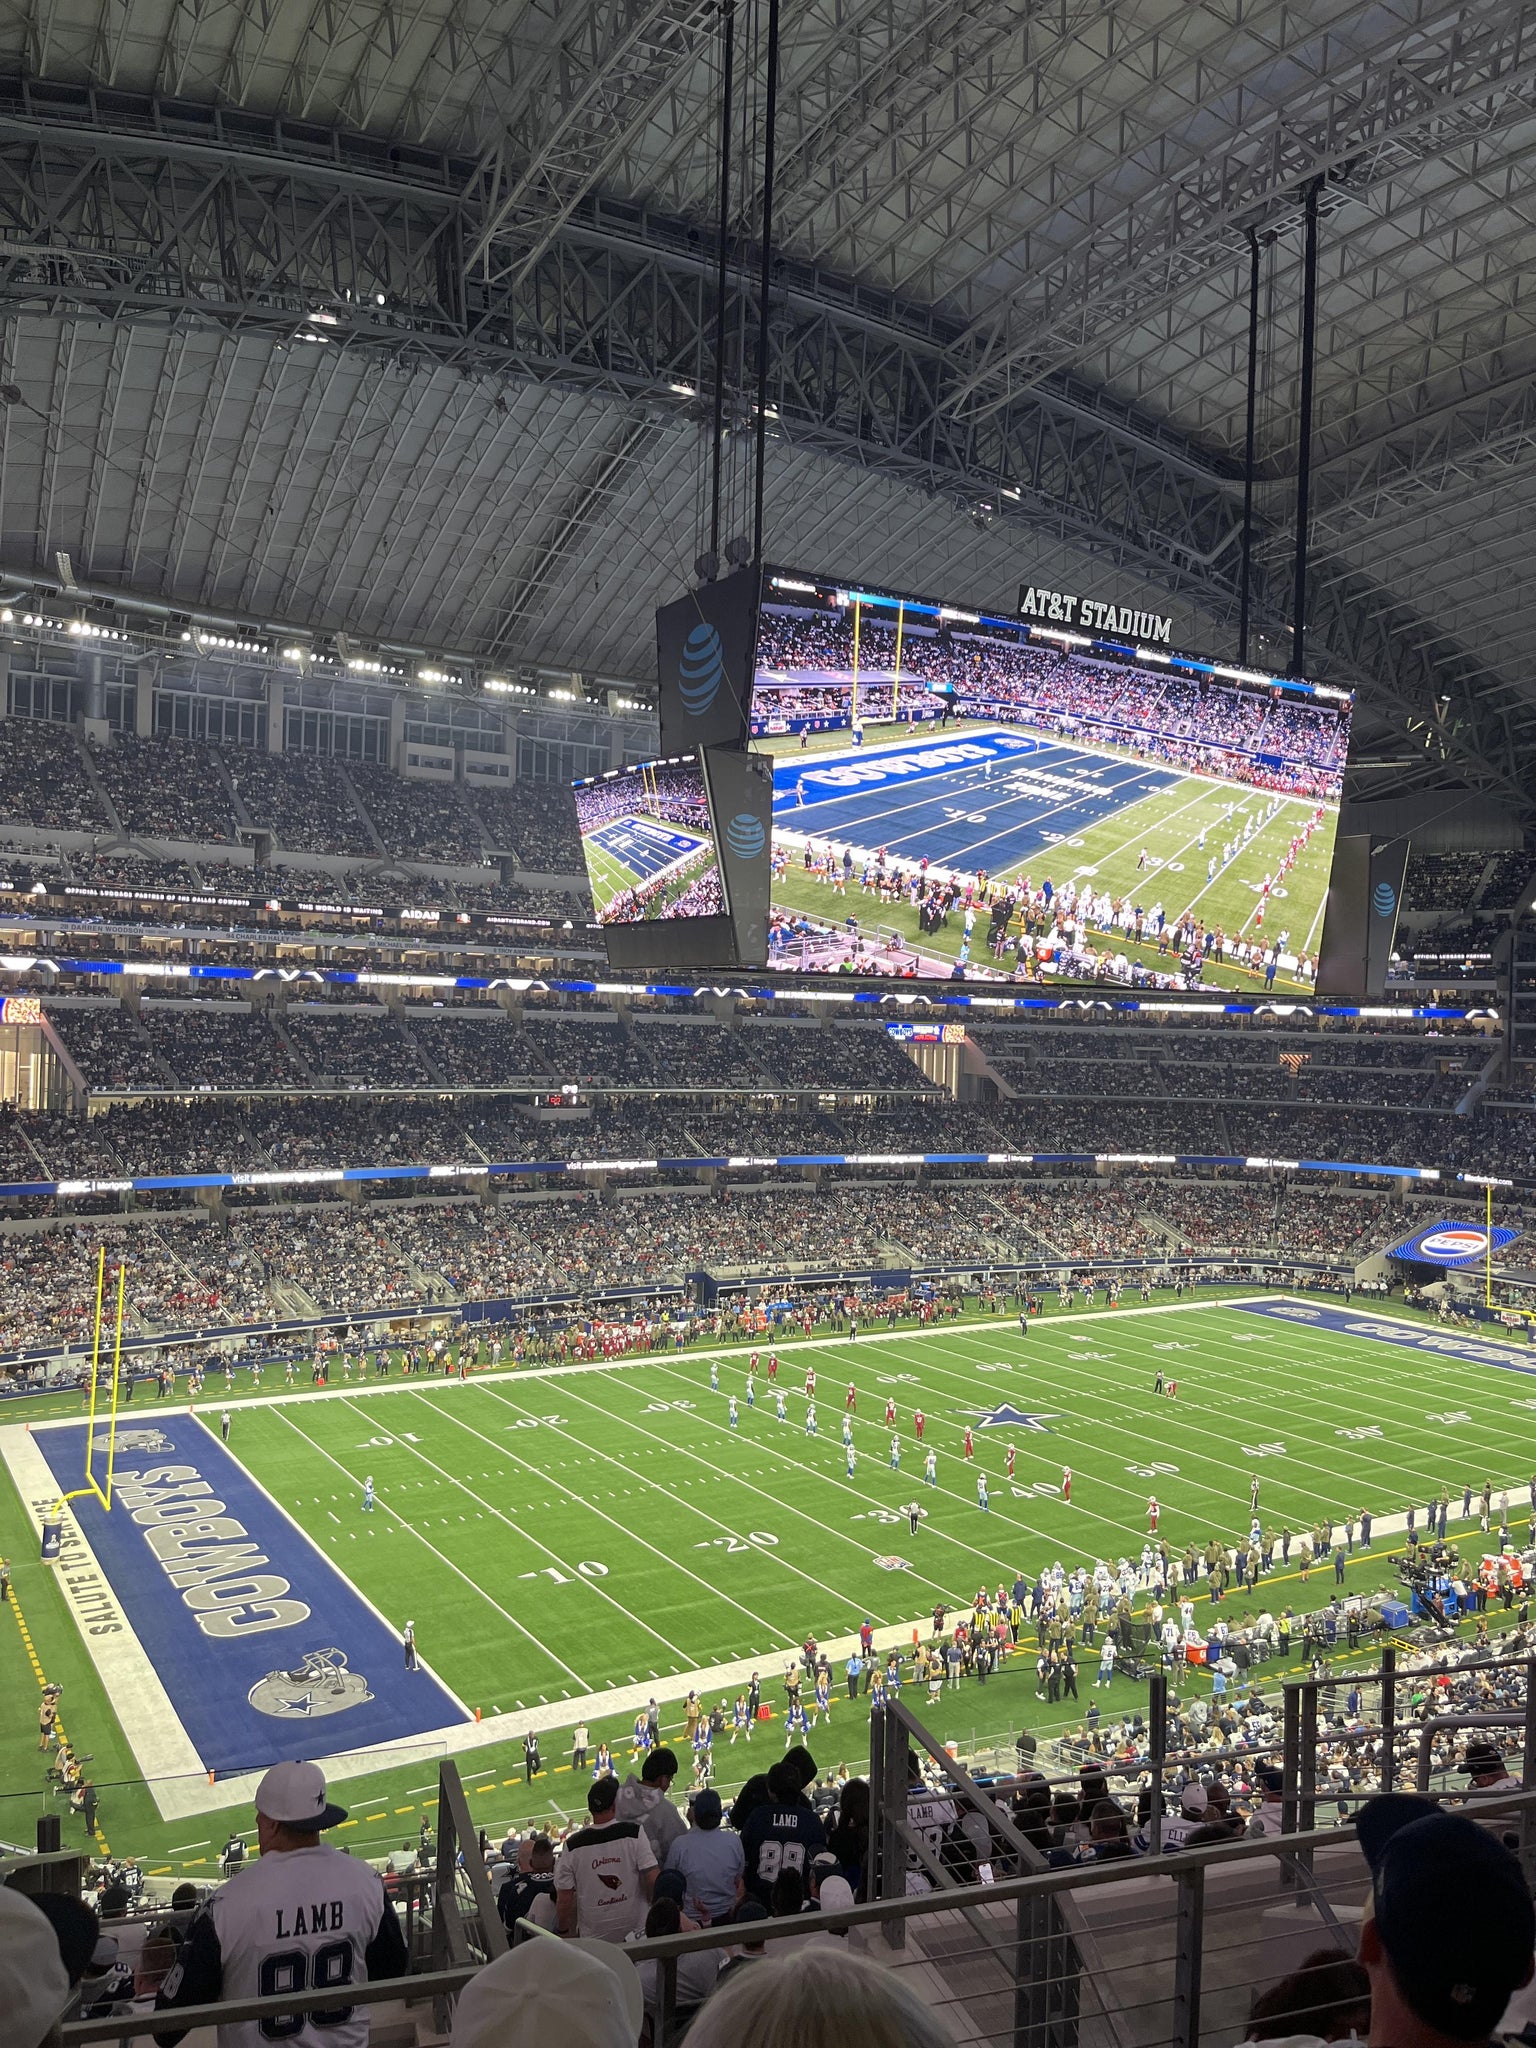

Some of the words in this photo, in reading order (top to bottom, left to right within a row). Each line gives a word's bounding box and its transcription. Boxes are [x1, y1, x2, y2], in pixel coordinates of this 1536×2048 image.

[1020, 587, 1077, 622] AT&T
[1080, 599, 1173, 643] STADIUM
[801, 744, 998, 787] COWBOYS
[298, 903, 314, 911] THE
[315, 904, 342, 912] WORLD
[353, 907, 384, 916] WAITING
[401, 910, 440, 920] AIDAN
[71, 923, 103, 932] DARREN
[105, 925, 144, 934] WOODSON
[235, 933, 267, 941] CHARLES
[231, 1174, 250, 1184] visit
[1429, 1237, 1480, 1250] PEPSI
[515, 1414, 569, 1429] 20
[369, 1432, 425, 1447] 10
[1241, 1442, 1288, 1457] 40
[1123, 1461, 1181, 1478] 50
[1010, 1482, 1062, 1499] 40
[712, 1531, 780, 1553] 20
[106, 1465, 312, 1638] COWBOYS
[60, 1552, 92, 1572] TO
[540, 1560, 610, 1585] 10
[66, 1573, 124, 1636] SALUTE
[1166, 1628, 1174, 1638] 71
[909, 1805, 933, 1820] LAMB
[772, 1813, 798, 1828] LAMB
[591, 1856, 621, 1870] Arizona
[757, 1840, 806, 1883] 88
[598, 1893, 628, 1907] Cardinals
[275, 1900, 345, 1939] LAMB
[258, 1936, 355, 2041] 88
